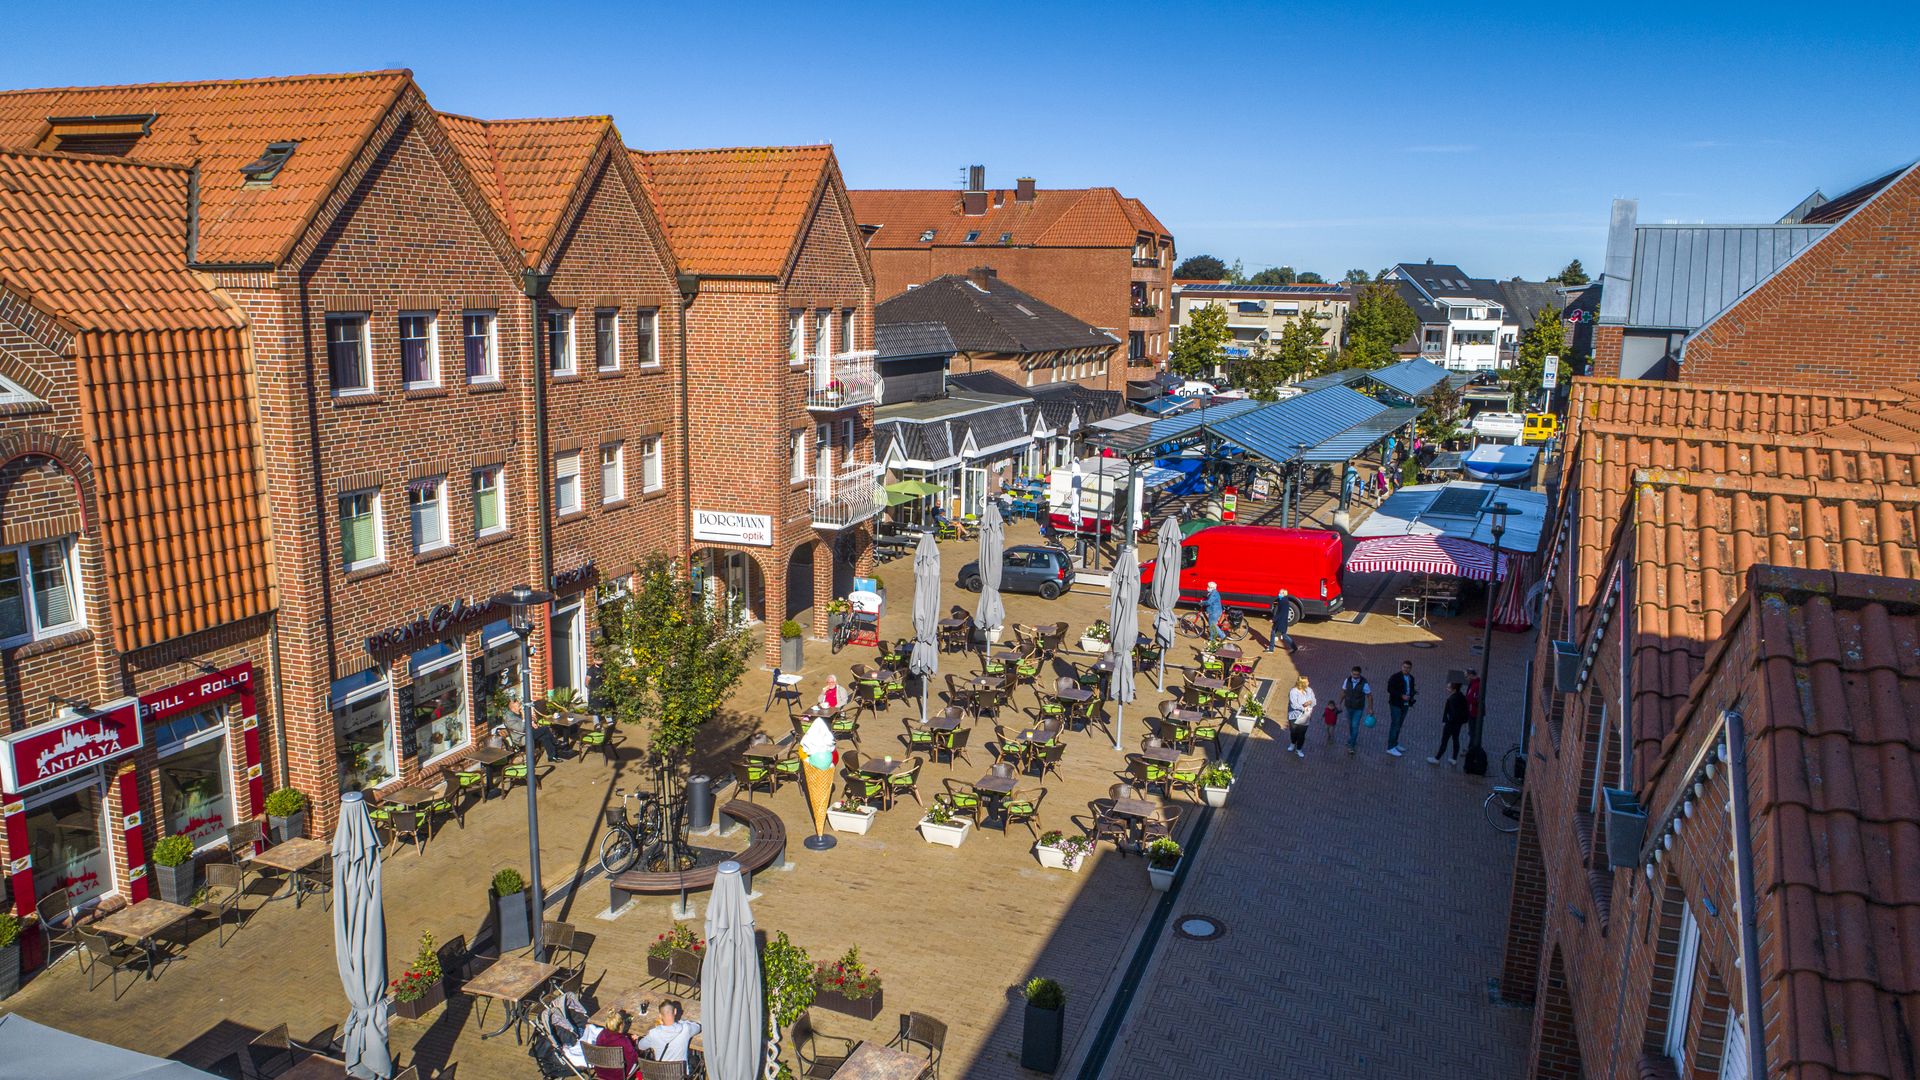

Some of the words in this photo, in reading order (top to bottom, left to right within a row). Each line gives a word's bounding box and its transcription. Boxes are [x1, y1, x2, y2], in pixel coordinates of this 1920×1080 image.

[1179, 388, 1198, 398] dpd
[699, 513, 765, 529] BORGMANN
[742, 532, 764, 541] optik
[37, 740, 122, 779] ANTALYA
